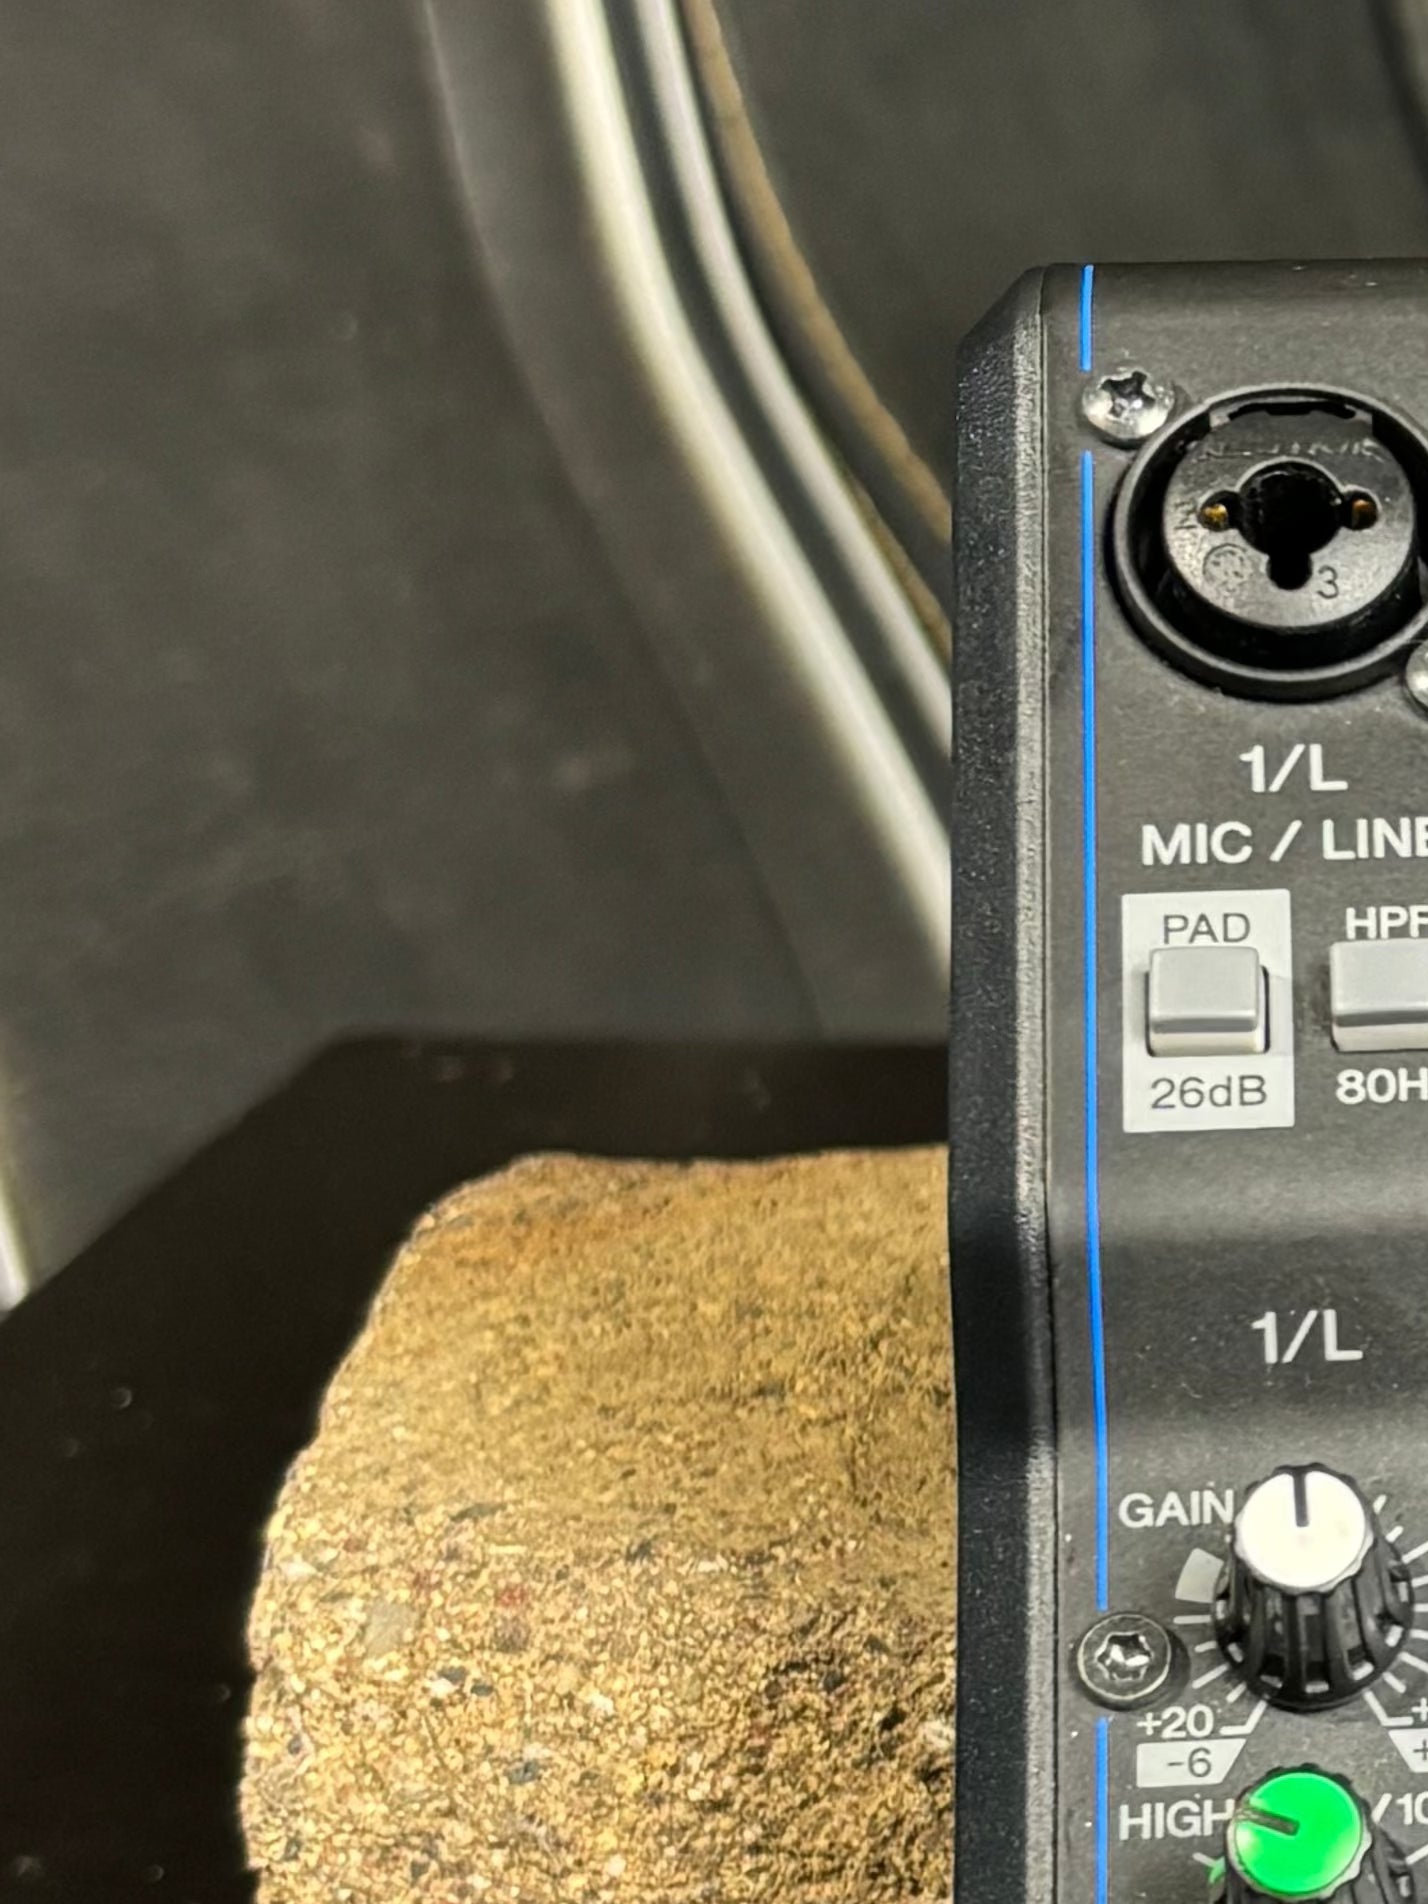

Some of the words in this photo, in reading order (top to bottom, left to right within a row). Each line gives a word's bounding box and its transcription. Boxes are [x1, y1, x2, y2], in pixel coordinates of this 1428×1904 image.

[1317, 565, 1338, 599] 3
[1239, 743, 1349, 793] 1/L
[1141, 821, 1253, 866] MIC
[1269, 819, 1303, 862] /
[1163, 912, 1251, 945] PAD
[1150, 1074, 1268, 1110] 26dB
[1251, 1308, 1364, 1364] 1/L
[1118, 1488, 1234, 1529] GAIN
[1135, 1703, 1214, 1740] +20
[1167, 1746, 1212, 1778] -6
[1118, 1798, 1235, 1841] HIGH
